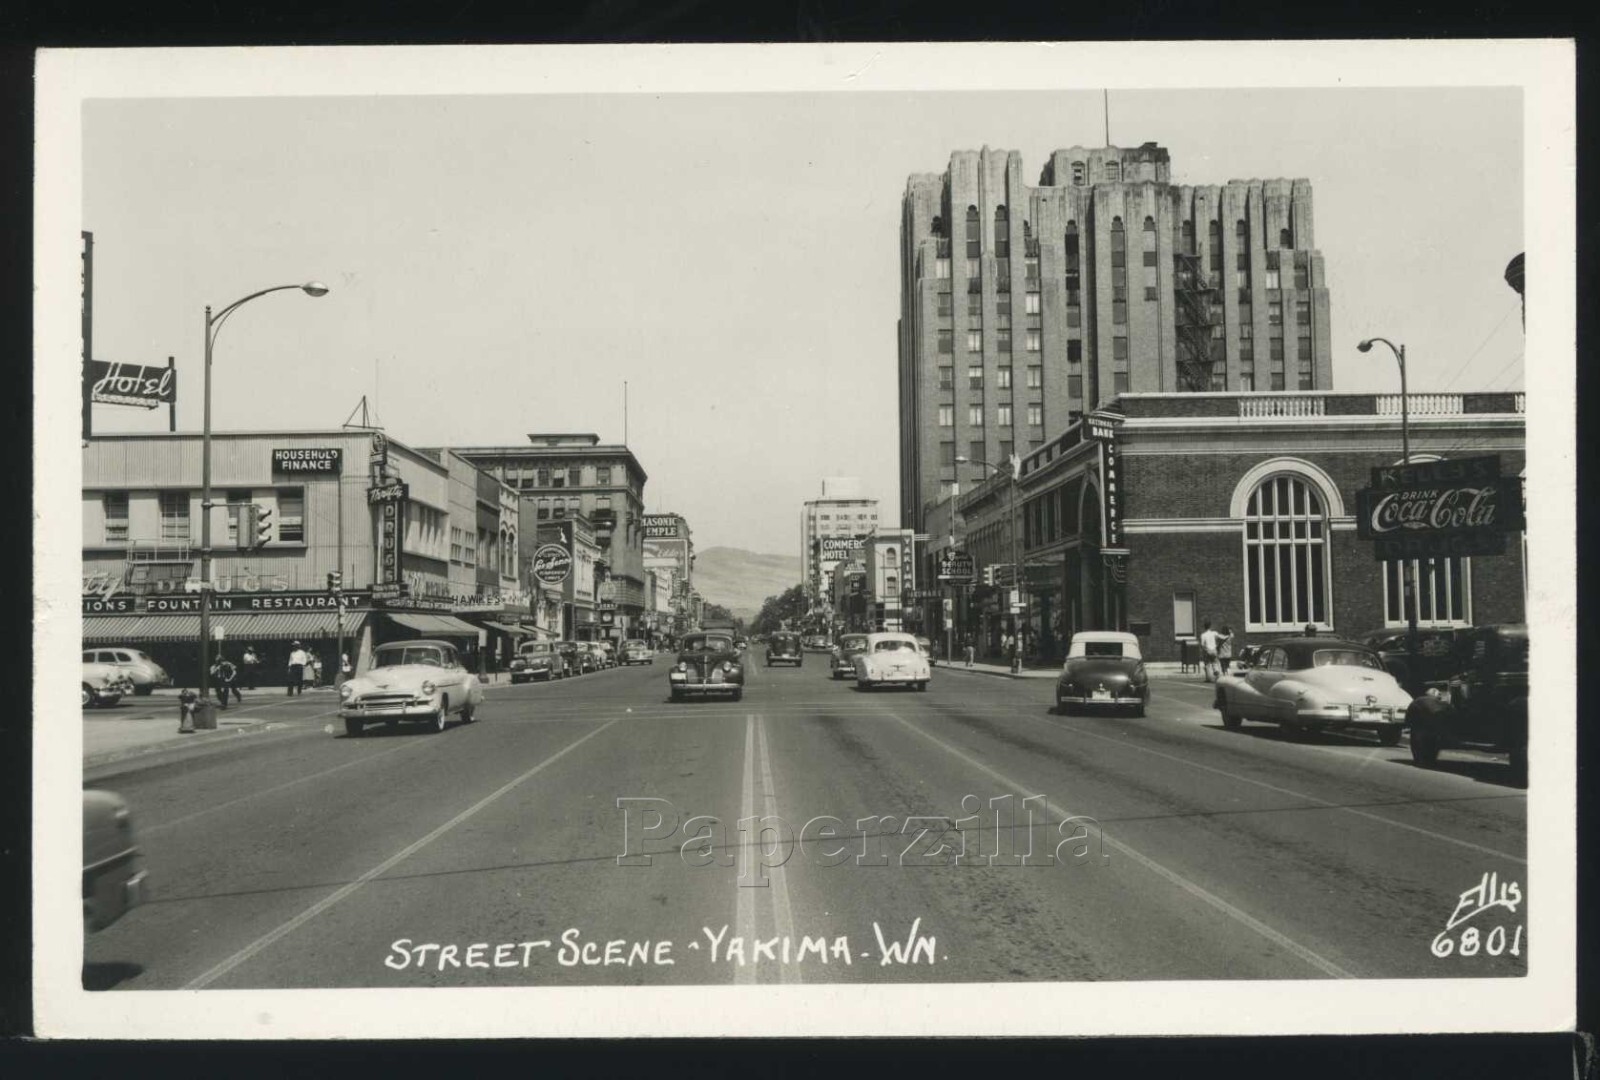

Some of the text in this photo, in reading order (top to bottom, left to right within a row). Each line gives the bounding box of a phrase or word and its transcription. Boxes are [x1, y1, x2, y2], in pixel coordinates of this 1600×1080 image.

[92, 361, 173, 396] Hotel
[282, 460, 332, 470] FINANCE
[1401, 490, 1438, 500] DRINK
[643, 527, 677, 537] EMPLE
[385, 504, 396, 584] DRUGS
[823, 549, 849, 560] HOTEL
[147, 599, 232, 611] FOUNTIN
[251, 597, 360, 608] RESTAURANT
